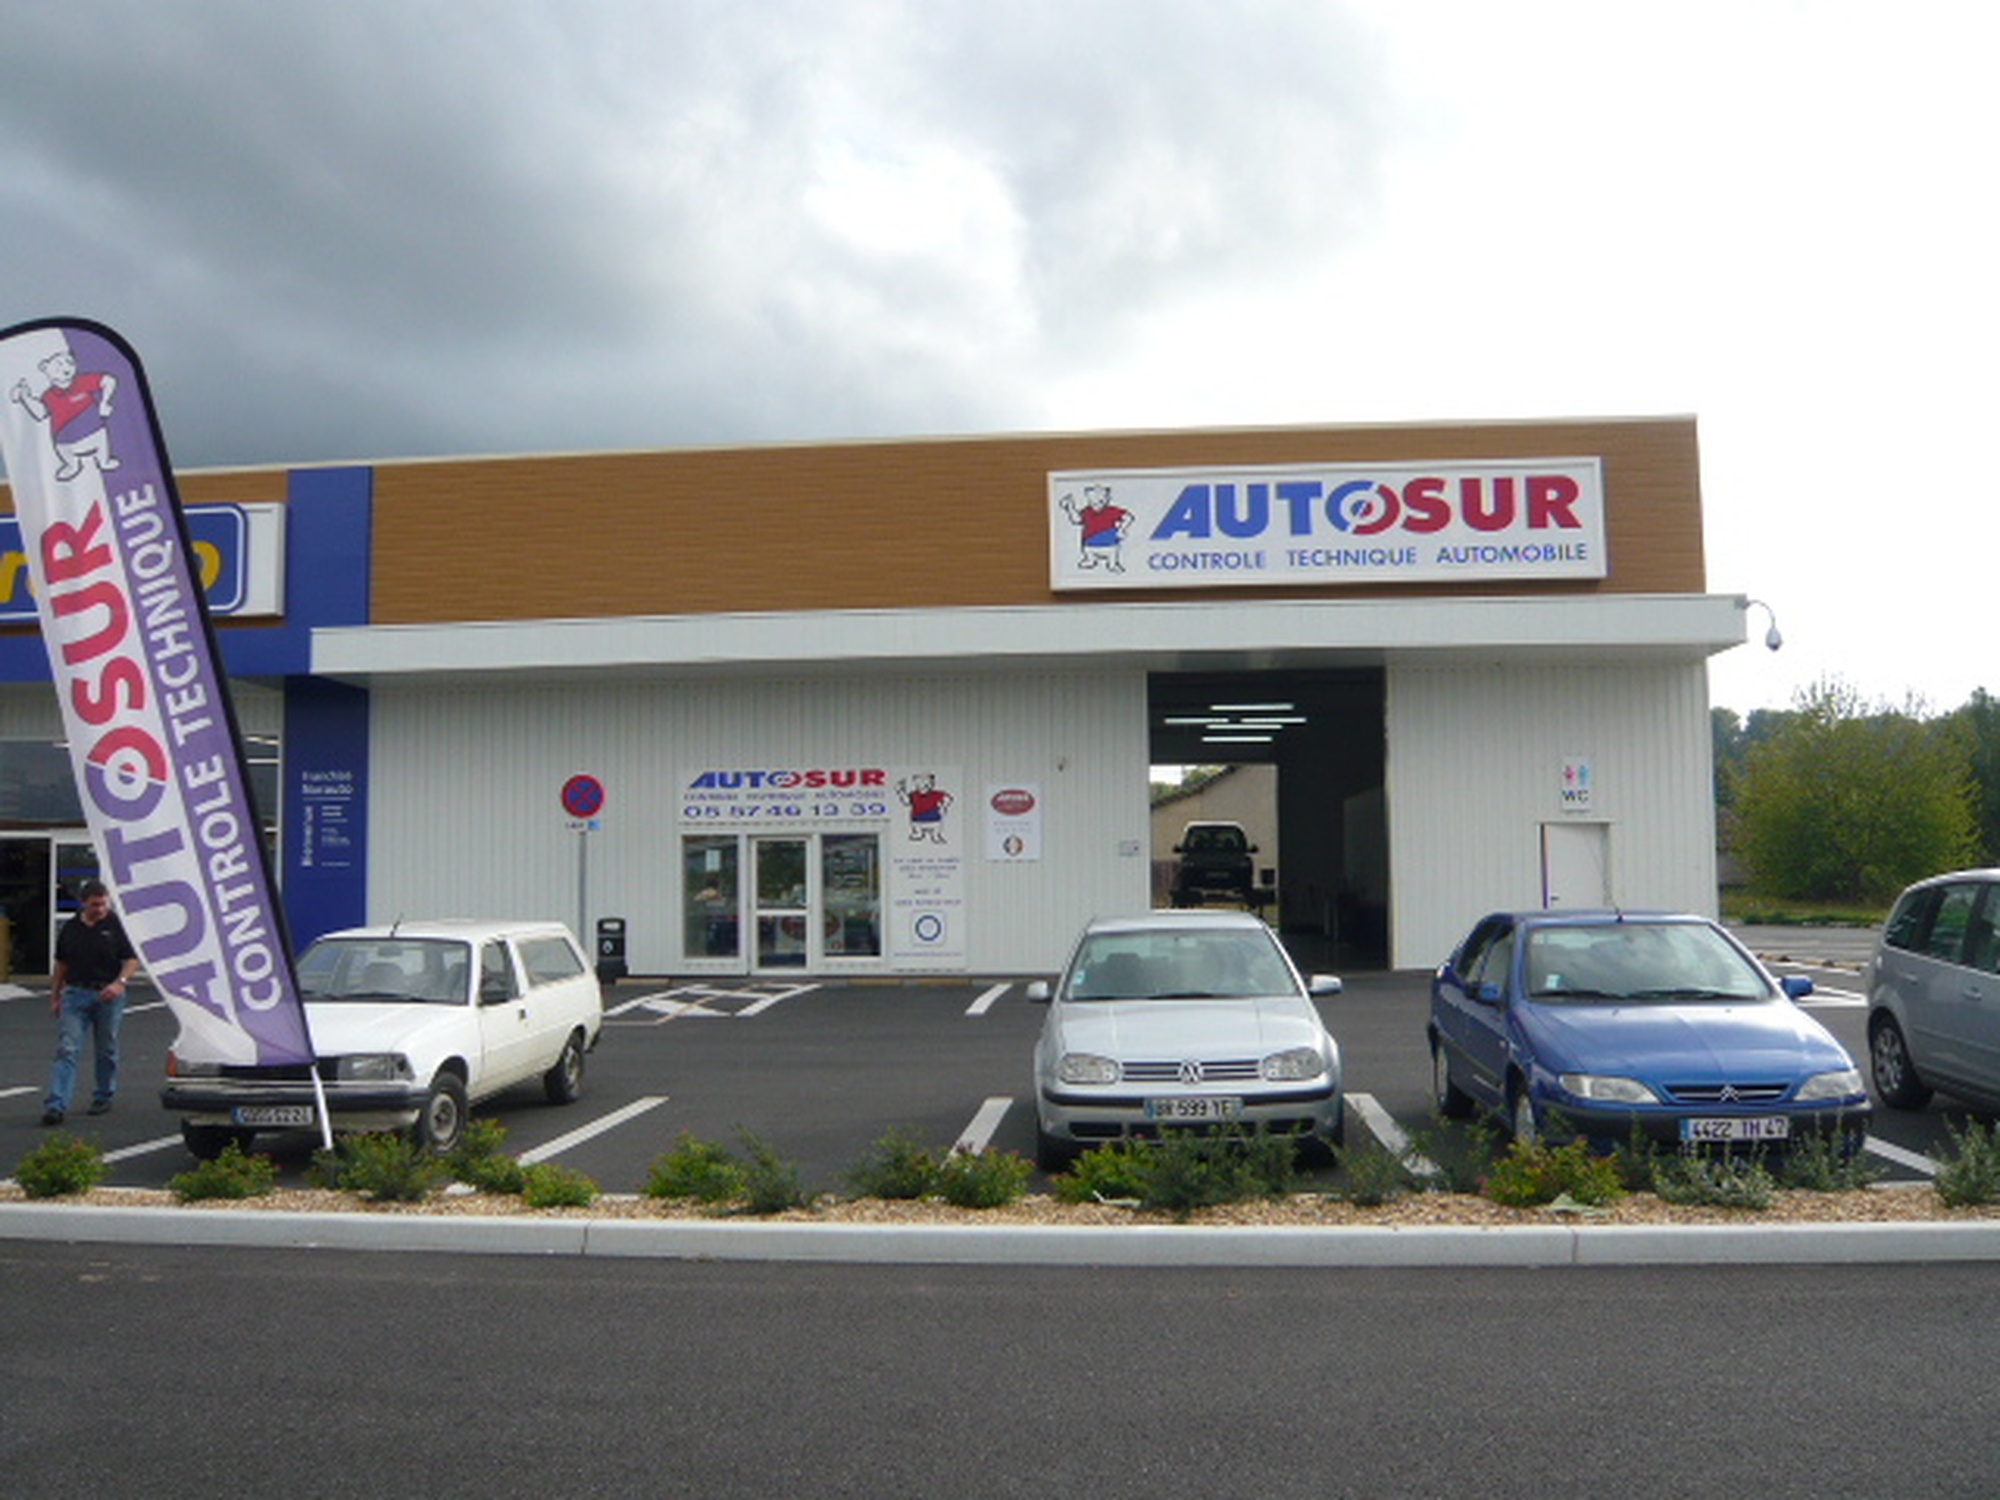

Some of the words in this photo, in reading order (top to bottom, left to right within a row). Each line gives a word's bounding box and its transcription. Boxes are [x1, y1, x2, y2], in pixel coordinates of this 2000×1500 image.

[1150, 475, 1583, 541] AUTOSUR
[1147, 551, 1267, 570] CONTROLE
[1287, 547, 1417, 567] TECHNIQUE
[1436, 543, 1588, 564] AUTOMOBILE
[115, 485, 213, 748] TECHNIQUE
[41, 499, 232, 1026] AUTOSUR
[689, 768, 887, 789] AUTOSUR
[683, 805, 720, 818] 05
[1562, 789, 1589, 801] WC
[183, 753, 282, 1012] CONTROLE
